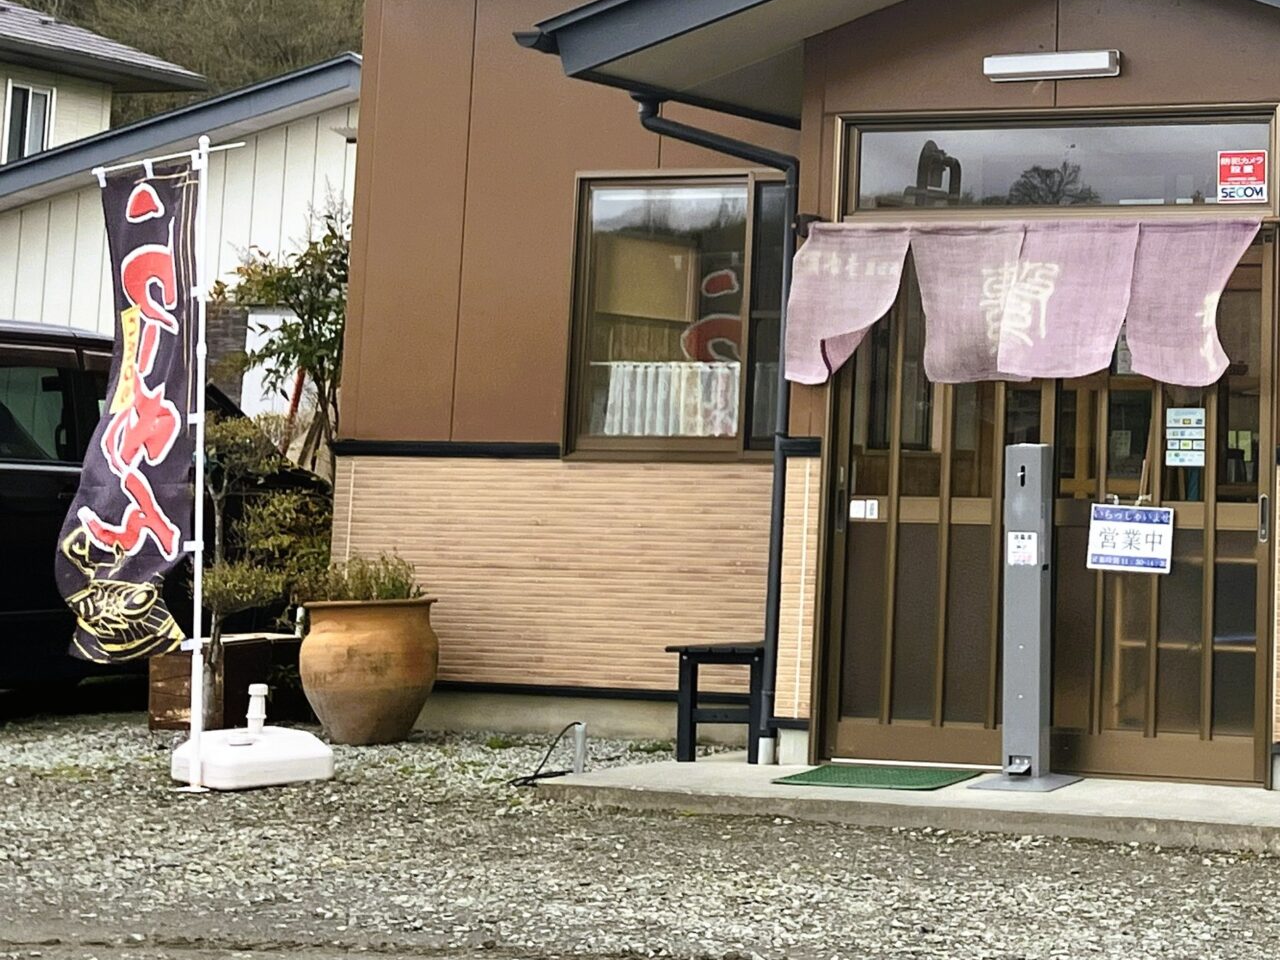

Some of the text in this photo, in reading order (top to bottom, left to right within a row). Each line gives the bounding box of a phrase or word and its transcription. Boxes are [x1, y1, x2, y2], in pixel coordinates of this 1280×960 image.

[1221, 186, 1263, 198] SECOM
[1099, 526, 1163, 552] 営業中
